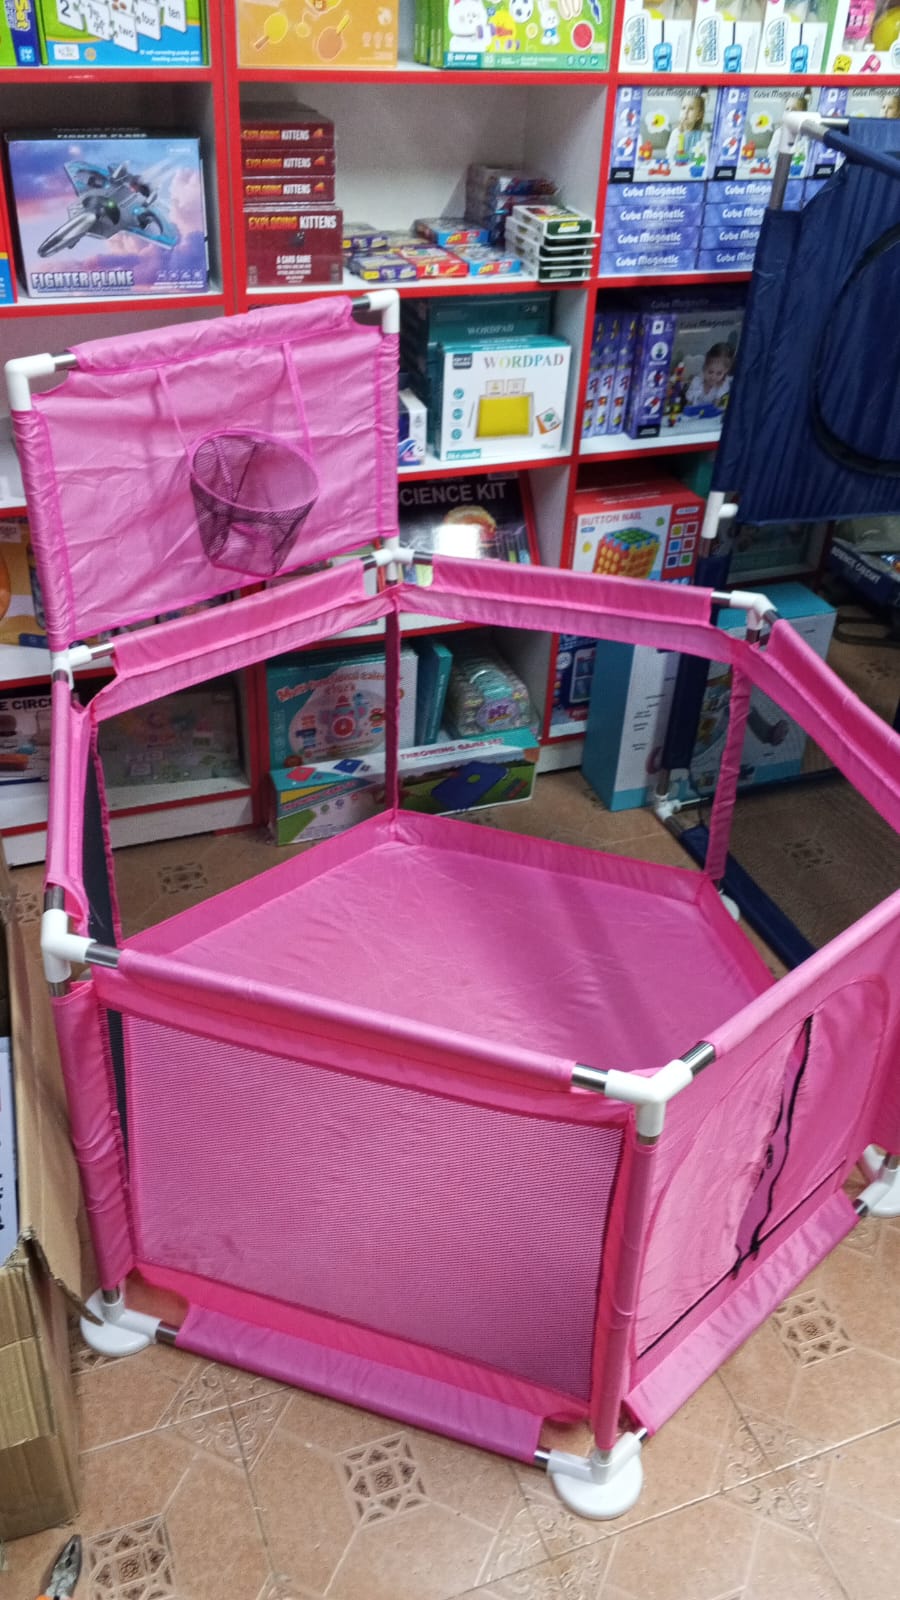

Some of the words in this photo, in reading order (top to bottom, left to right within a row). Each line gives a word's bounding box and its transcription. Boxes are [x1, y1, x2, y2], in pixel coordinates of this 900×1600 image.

[281, 129, 310, 141] KITTENS
[283, 157, 312, 169] KITTENS
[283, 183, 312, 195] KITTENS
[623, 186, 644, 197] Cube
[645, 185, 688, 198] Magnetic
[724, 184, 745, 196] Cube
[620, 210, 641, 221] Cube
[642, 208, 685, 221] Magnetic
[722, 208, 742, 218] Cube
[248, 216, 298, 231] EXPLODING
[299, 215, 337, 229] KITTENS
[617, 234, 639, 244] Cube
[640, 231, 682, 243] Magnetic
[719, 231, 739, 241] Cube
[615, 256, 637, 266] Cube
[637, 254, 679, 266] Magnetic
[716, 253, 736, 263] Cube
[31, 271, 88, 289] FIGHTER
[89, 270, 134, 288] PLANE
[467, 324, 515, 335] WORDPAD
[483, 353, 565, 369] WORDPAD
[400, 484, 473, 507] CIENCE
[476, 482, 507, 500] KIT
[580, 514, 620, 527] BUTTON
[12, 698, 51, 710] CIRC
[400, 745, 456, 759] THROWING
[457, 741, 485, 750] GAME
